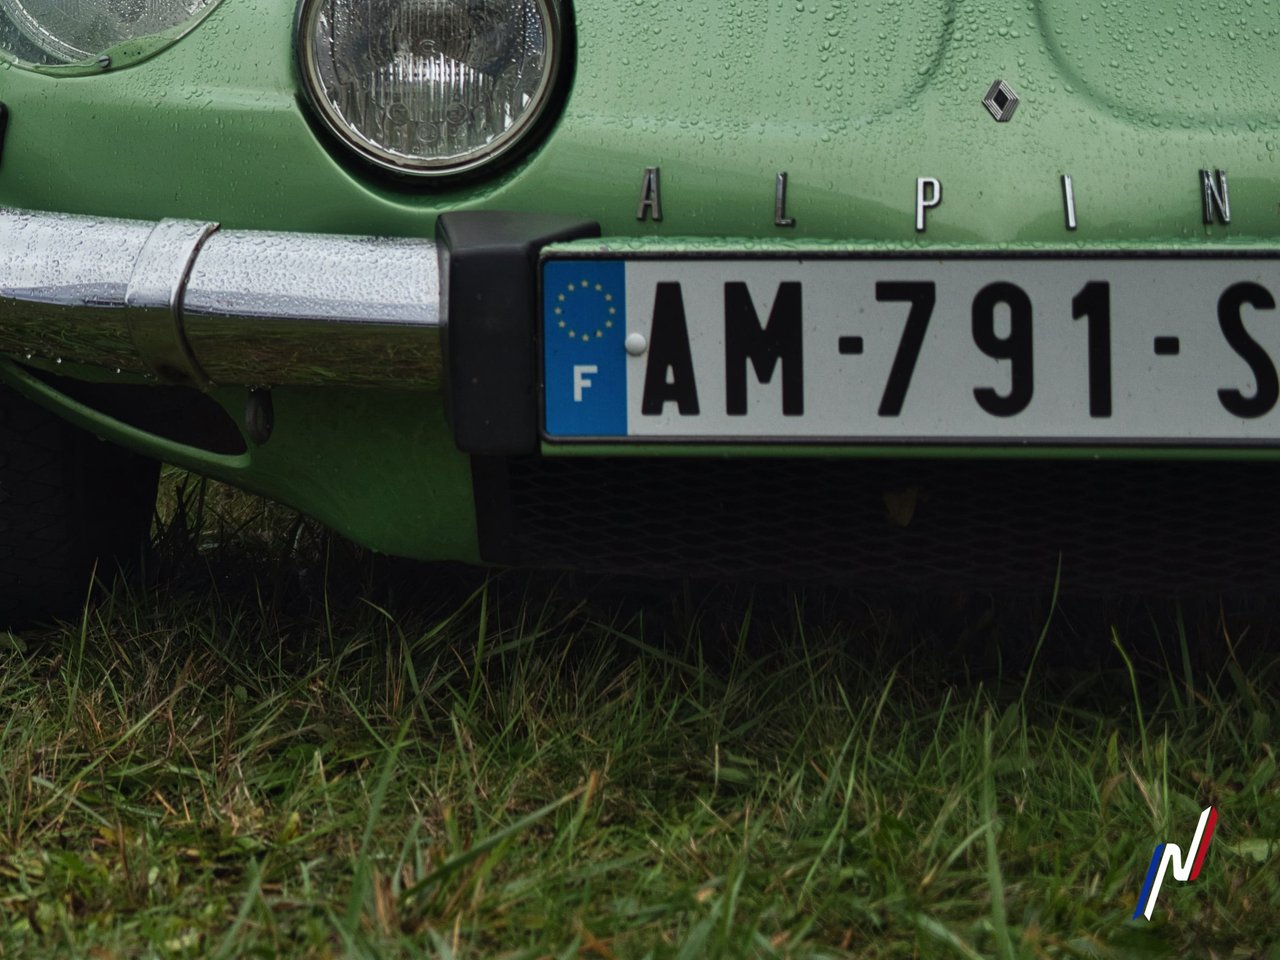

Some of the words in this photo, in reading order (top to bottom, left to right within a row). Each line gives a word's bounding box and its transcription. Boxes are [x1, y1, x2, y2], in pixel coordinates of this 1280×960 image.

[635, 165, 1232, 234] ALPIN
[573, 364, 599, 402] F
[640, 280, 1280, 419] AM-791-S
